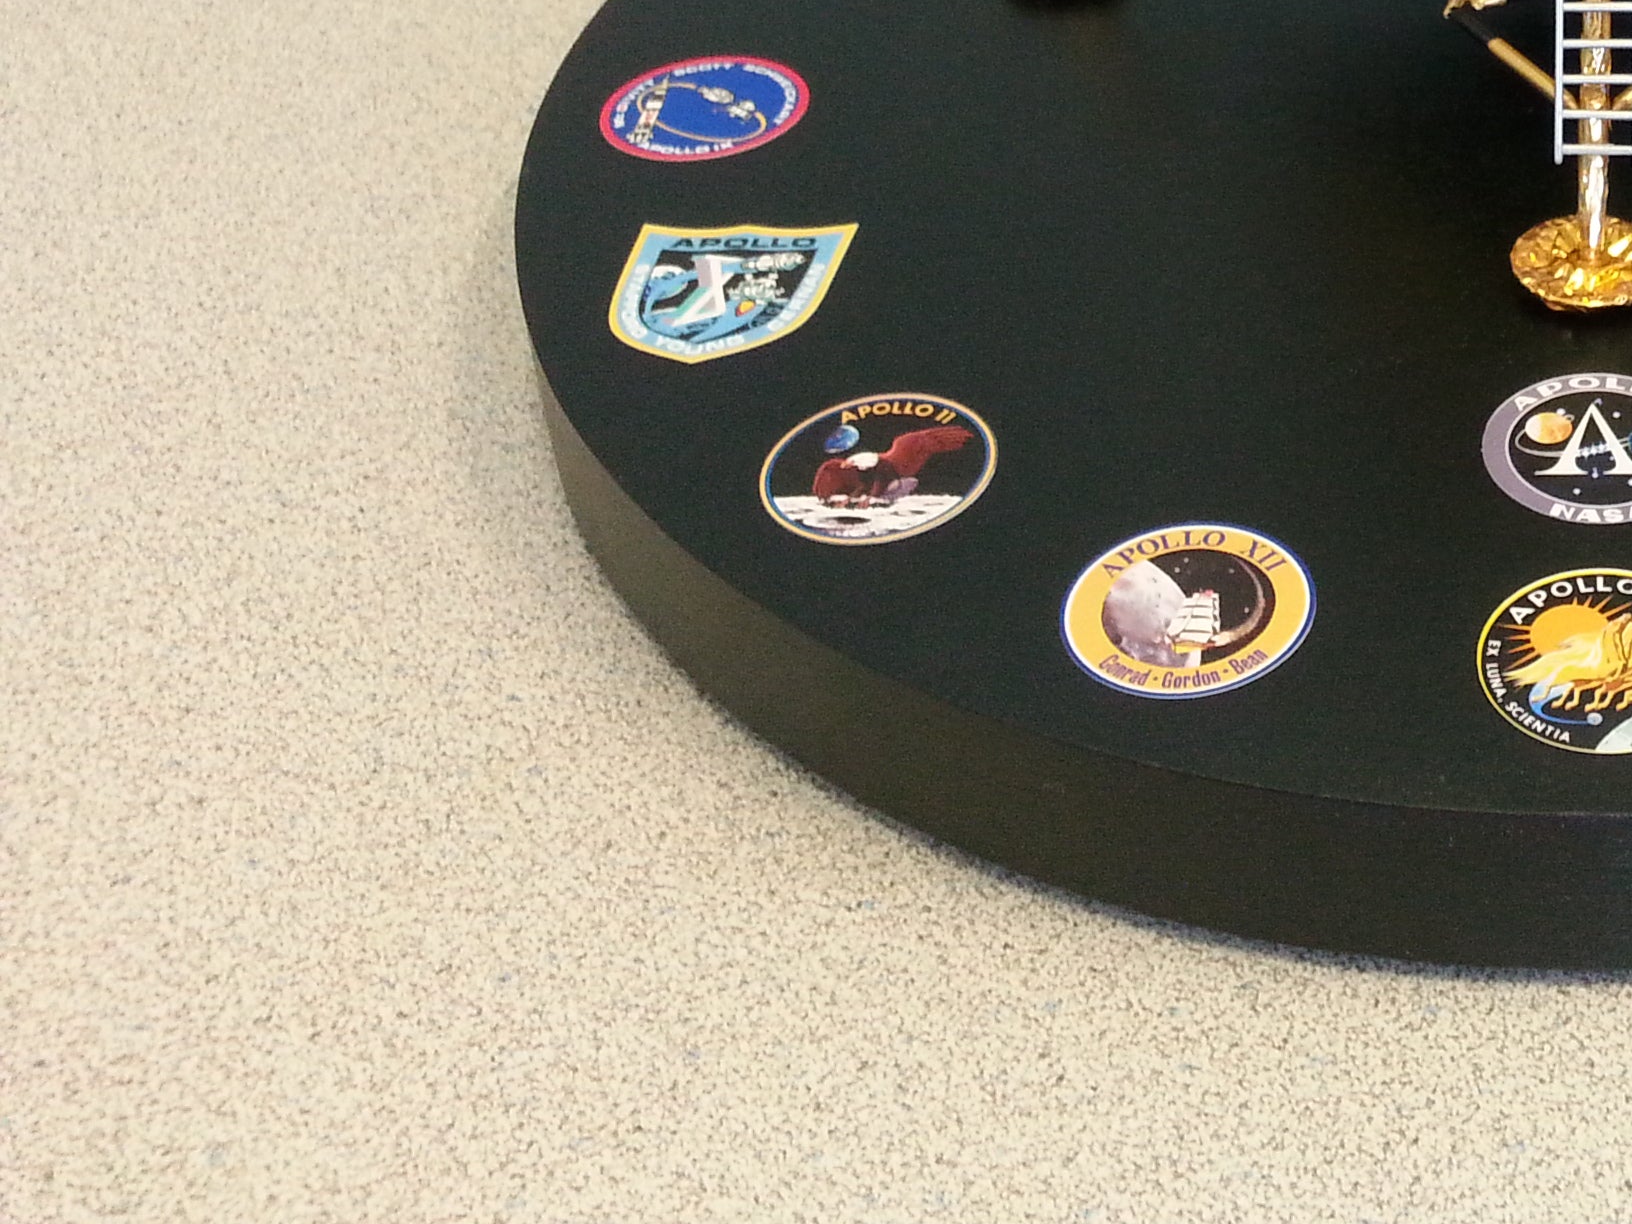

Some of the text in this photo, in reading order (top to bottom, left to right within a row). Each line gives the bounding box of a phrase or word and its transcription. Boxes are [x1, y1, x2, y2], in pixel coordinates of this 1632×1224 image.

[671, 237, 817, 249] APOLLO
[841, 401, 935, 424] APOLLO
[1100, 530, 1287, 579] APOLLO XII
[1098, 648, 1269, 690] Conrad Gordon Bean
[1485, 639, 1502, 658] EX
[1504, 701, 1571, 744] SCIENTIA
